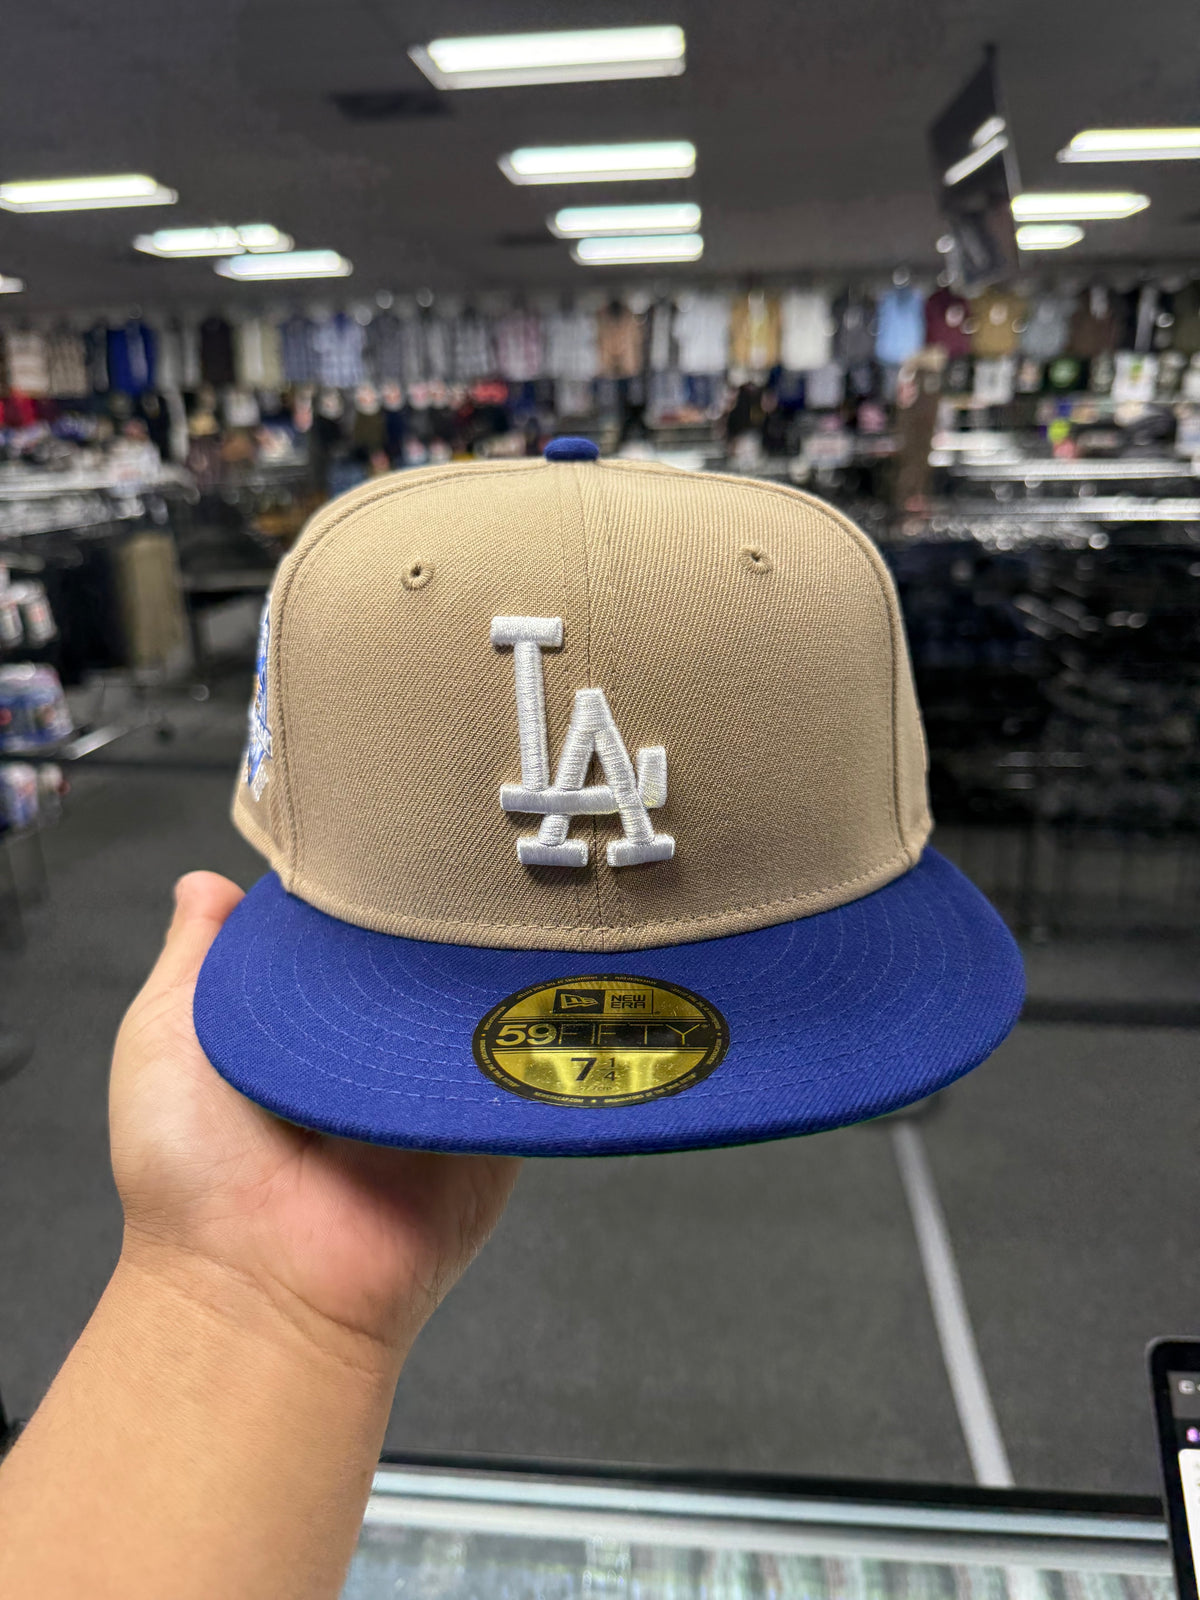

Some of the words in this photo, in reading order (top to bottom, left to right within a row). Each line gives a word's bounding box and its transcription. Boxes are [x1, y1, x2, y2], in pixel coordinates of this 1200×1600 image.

[490, 615, 675, 867] LA
[611, 994, 646, 1002] NEW
[611, 1002, 646, 1010] ERA
[495, 1023, 700, 1046] 59FIFTY
[571, 1057, 597, 1081] 7
